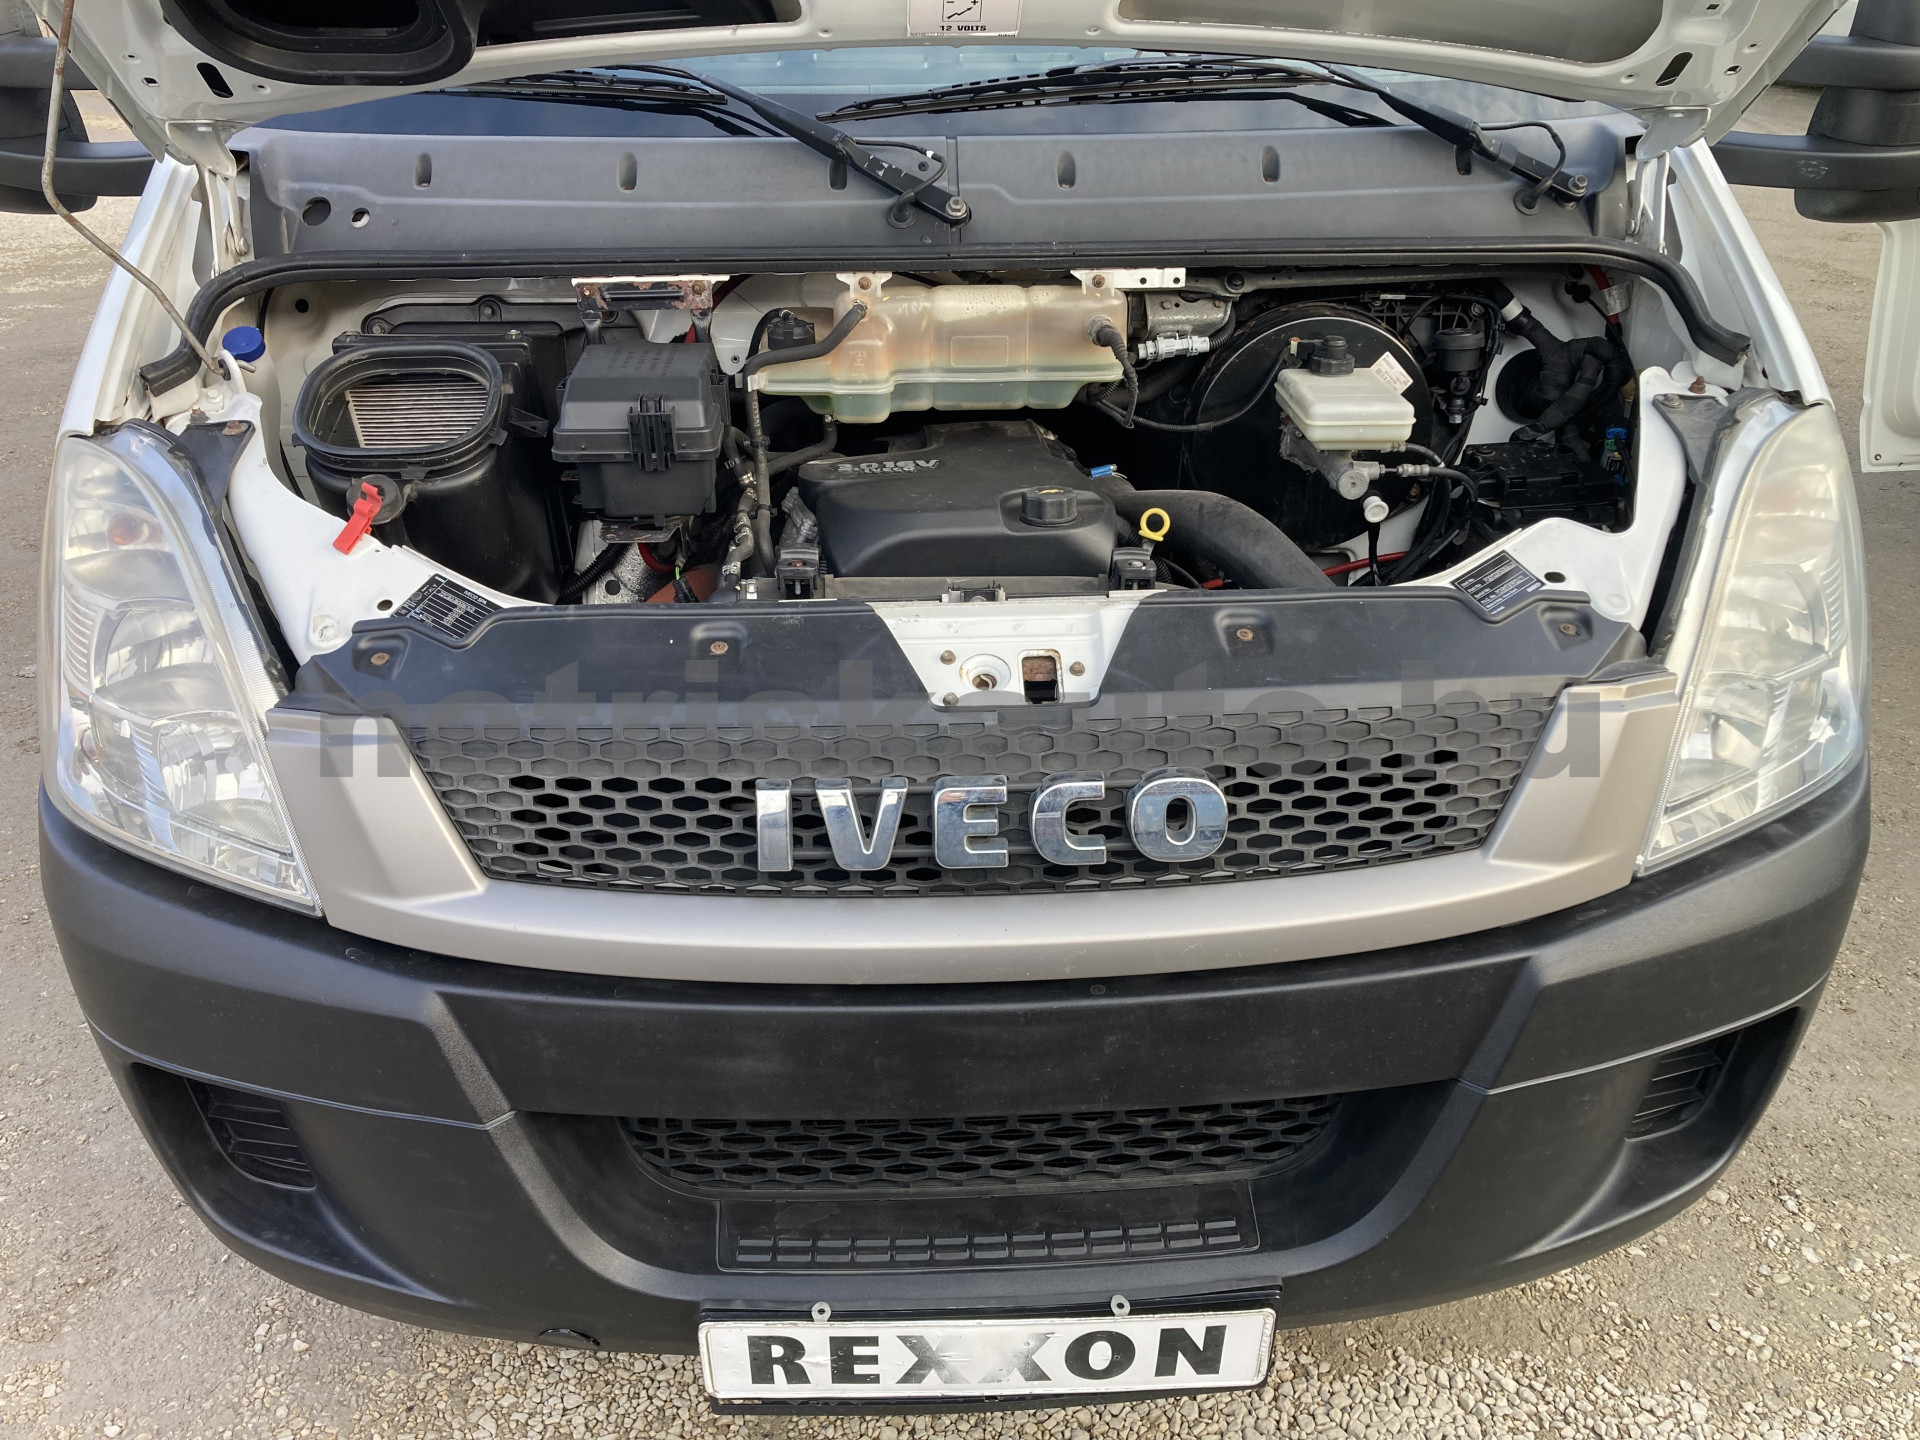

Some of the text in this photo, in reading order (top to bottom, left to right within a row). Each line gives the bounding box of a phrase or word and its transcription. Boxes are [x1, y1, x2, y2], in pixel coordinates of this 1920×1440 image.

[849, 350, 868, 359] MAX
[851, 372, 868, 380] MIN
[752, 401, 761, 427] IVECO
[755, 767, 1229, 873] IVECO
[747, 1324, 1228, 1386] REXXON
